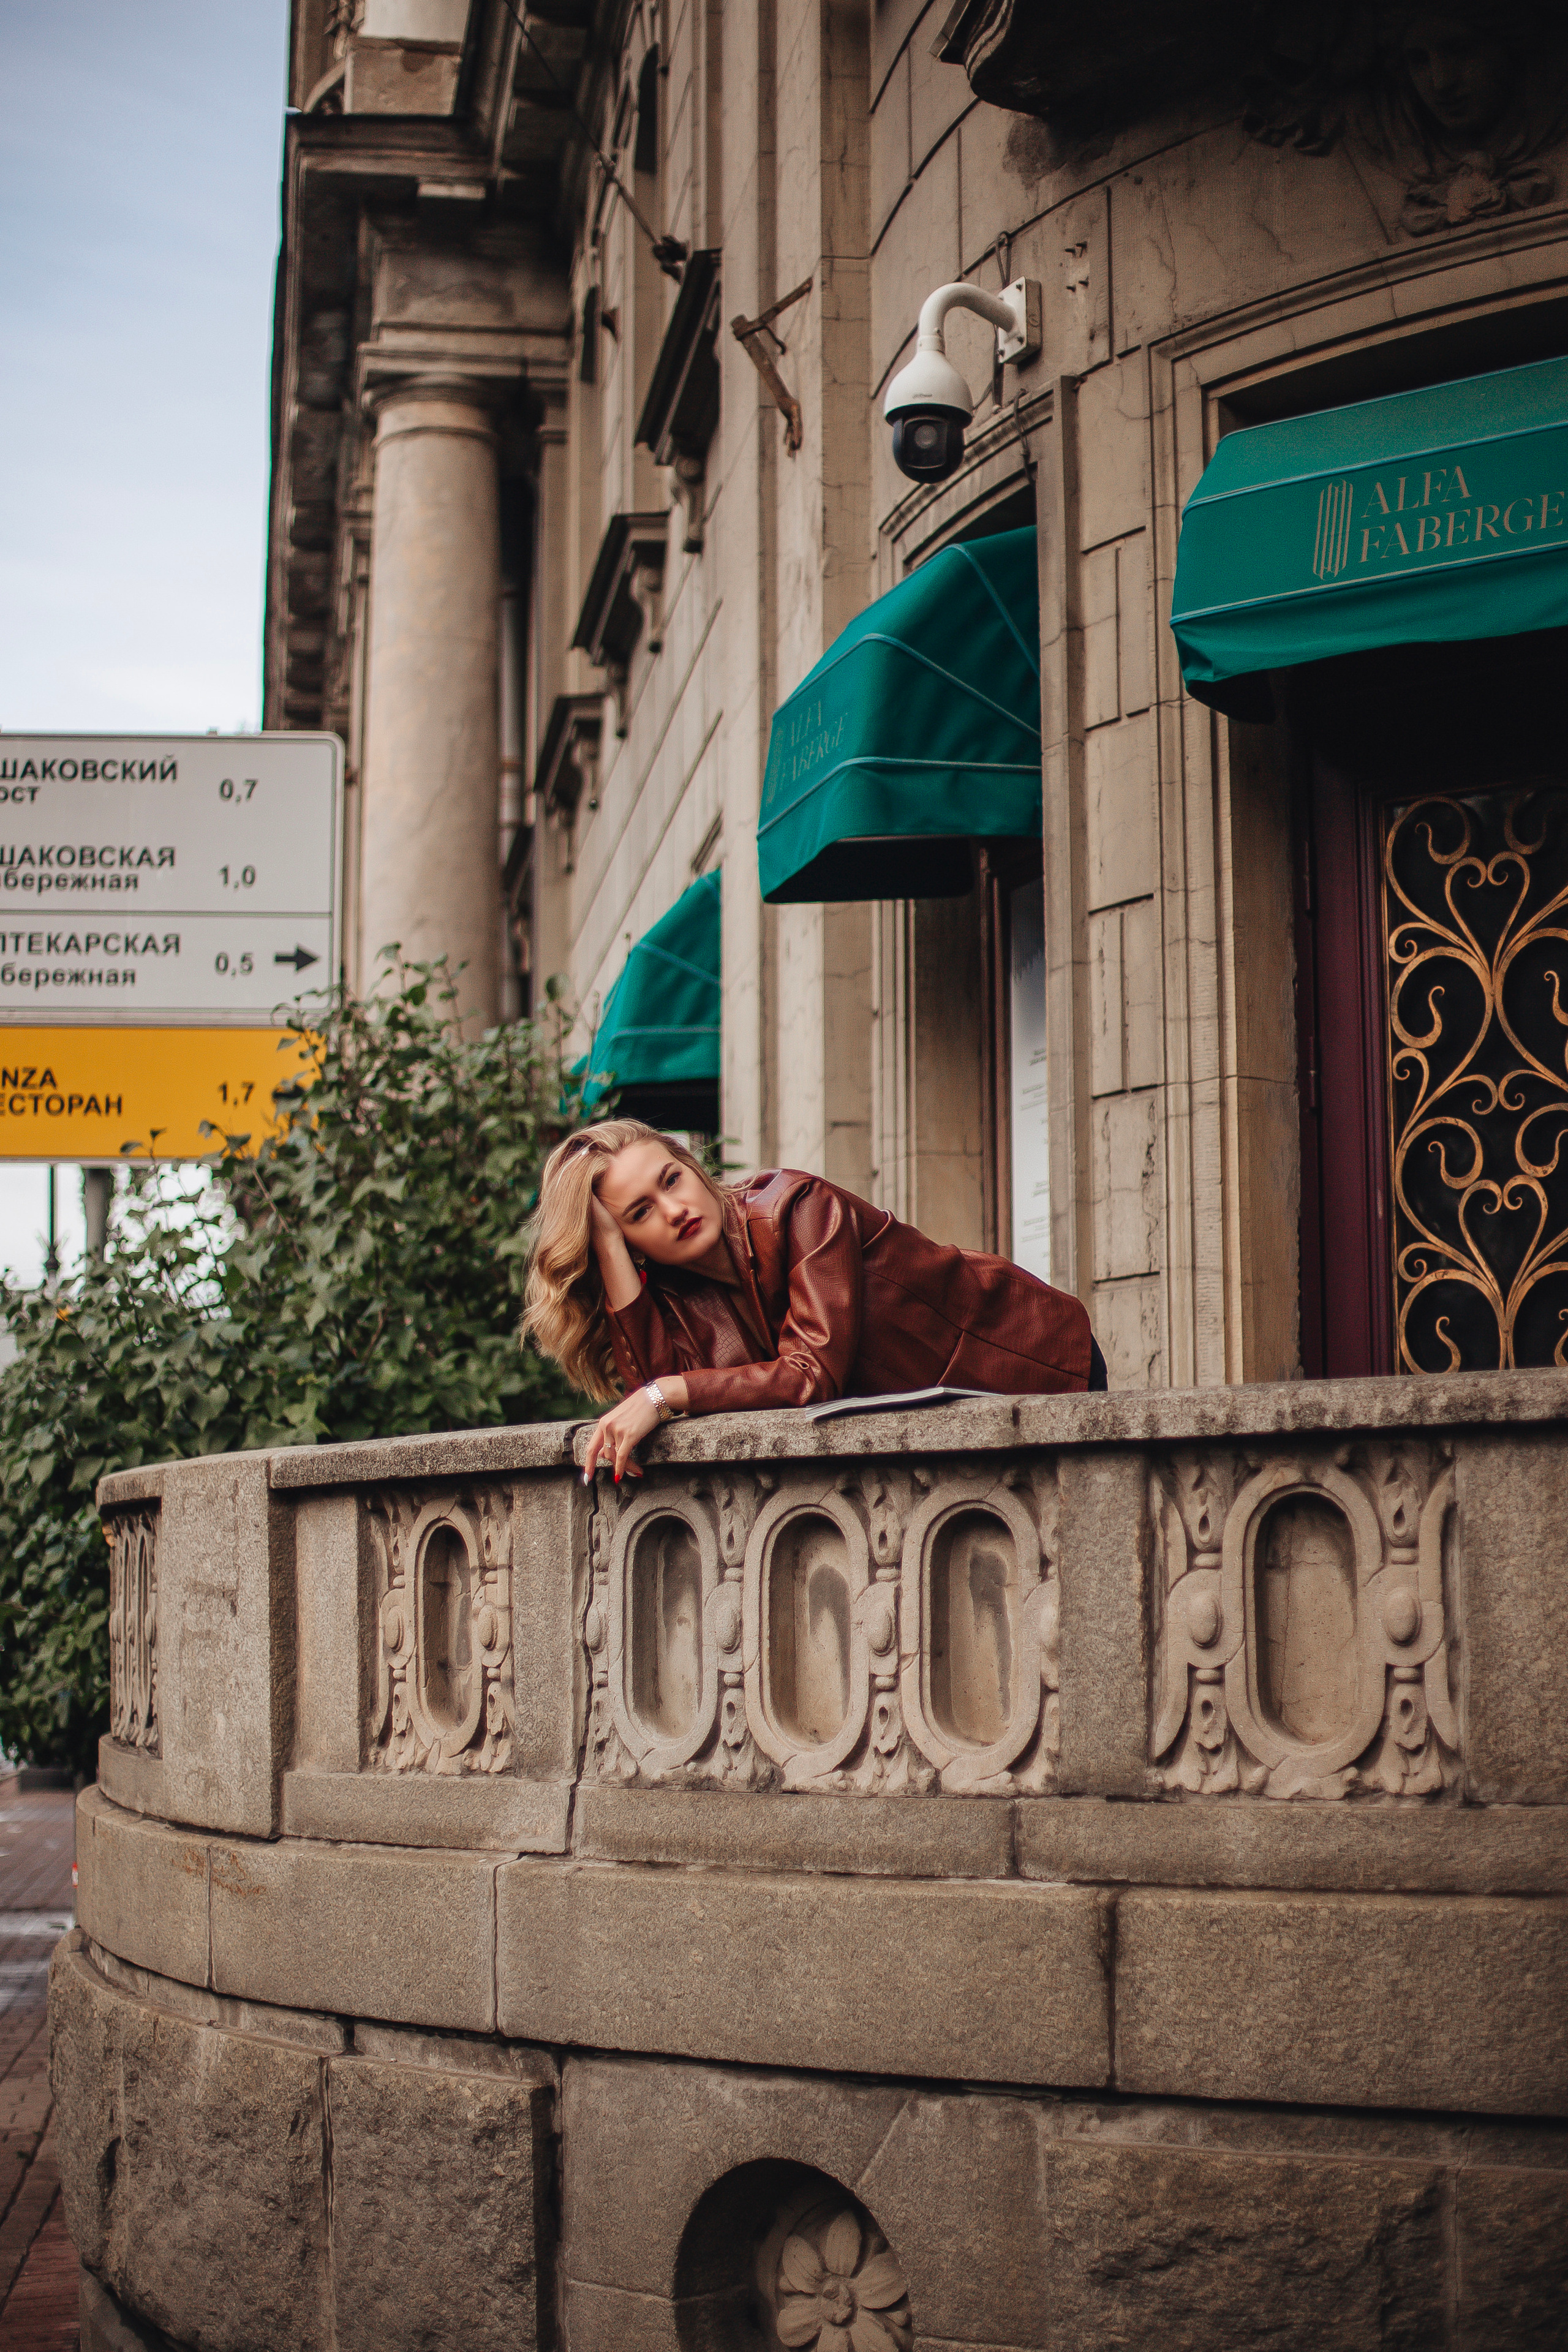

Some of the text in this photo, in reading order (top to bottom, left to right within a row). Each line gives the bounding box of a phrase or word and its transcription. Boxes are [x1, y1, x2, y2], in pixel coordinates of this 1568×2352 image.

[1361, 466, 1472, 518] ALFA
[1359, 491, 1565, 563] FABERGE
[0, 754, 178, 782] ШАКОВСКИЙ
[219, 778, 258, 804] 0,7
[0, 867, 138, 895] бережная
[219, 865, 256, 890] 1,0
[1, 962, 136, 990] бережная
[214, 952, 254, 978] 0,5
[1, 1066, 57, 1090] NZA
[218, 1081, 255, 1107] 1,7
